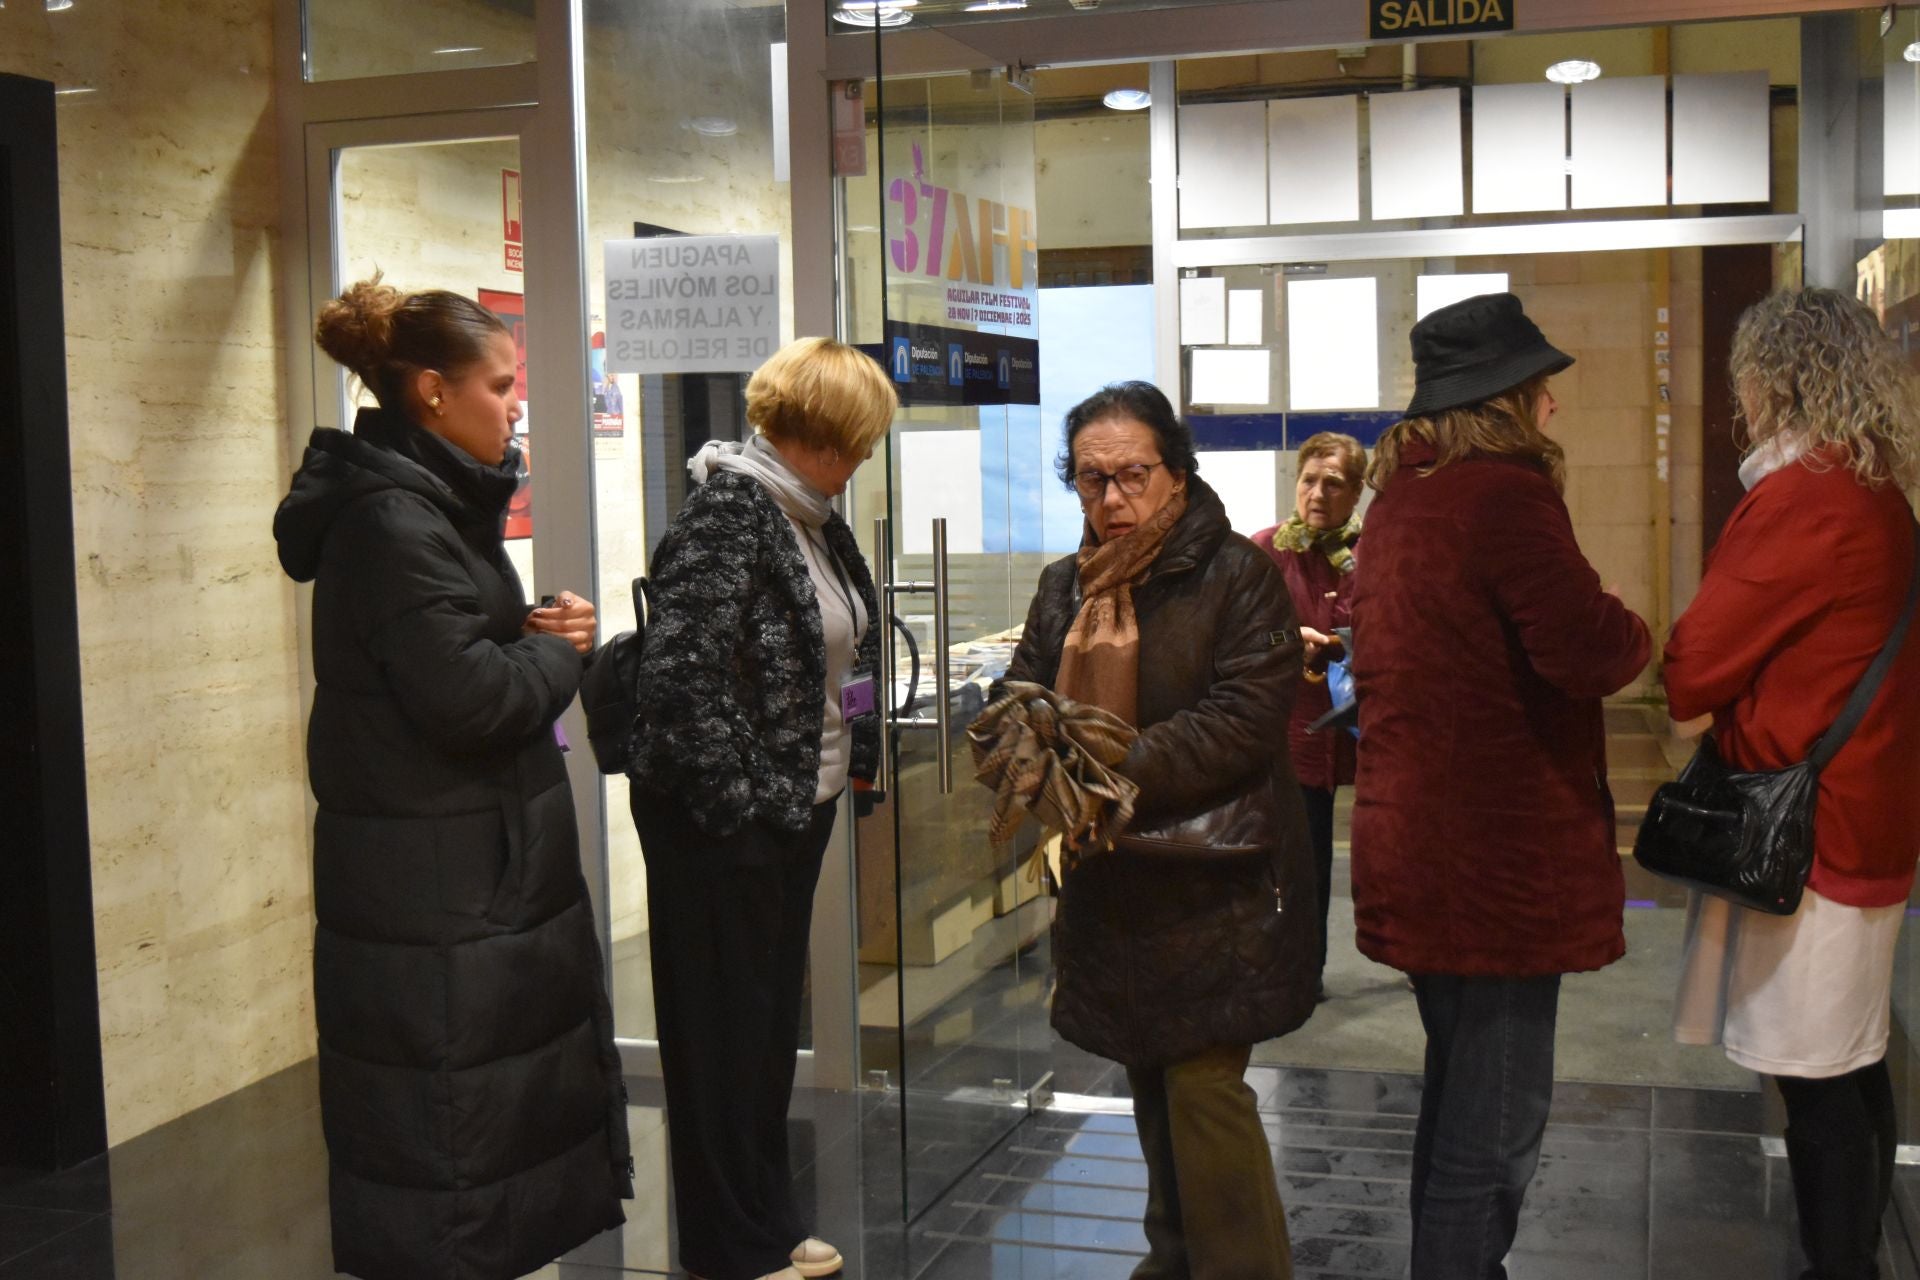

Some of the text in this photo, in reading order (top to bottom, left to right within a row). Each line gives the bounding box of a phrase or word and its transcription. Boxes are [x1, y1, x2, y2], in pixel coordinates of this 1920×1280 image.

[1379, 0, 1504, 30] SALIDA
[947, 288, 1031, 310] AGUILAR FILM FESTIVAL
[948, 307, 957, 320] 28
[957, 308, 970, 321] NOV
[980, 310, 1012, 324] DICIEMBRE
[1016, 312, 1031, 326] 2025
[911, 346, 938, 361] Diputación
[964, 351, 988, 365] Diputación
